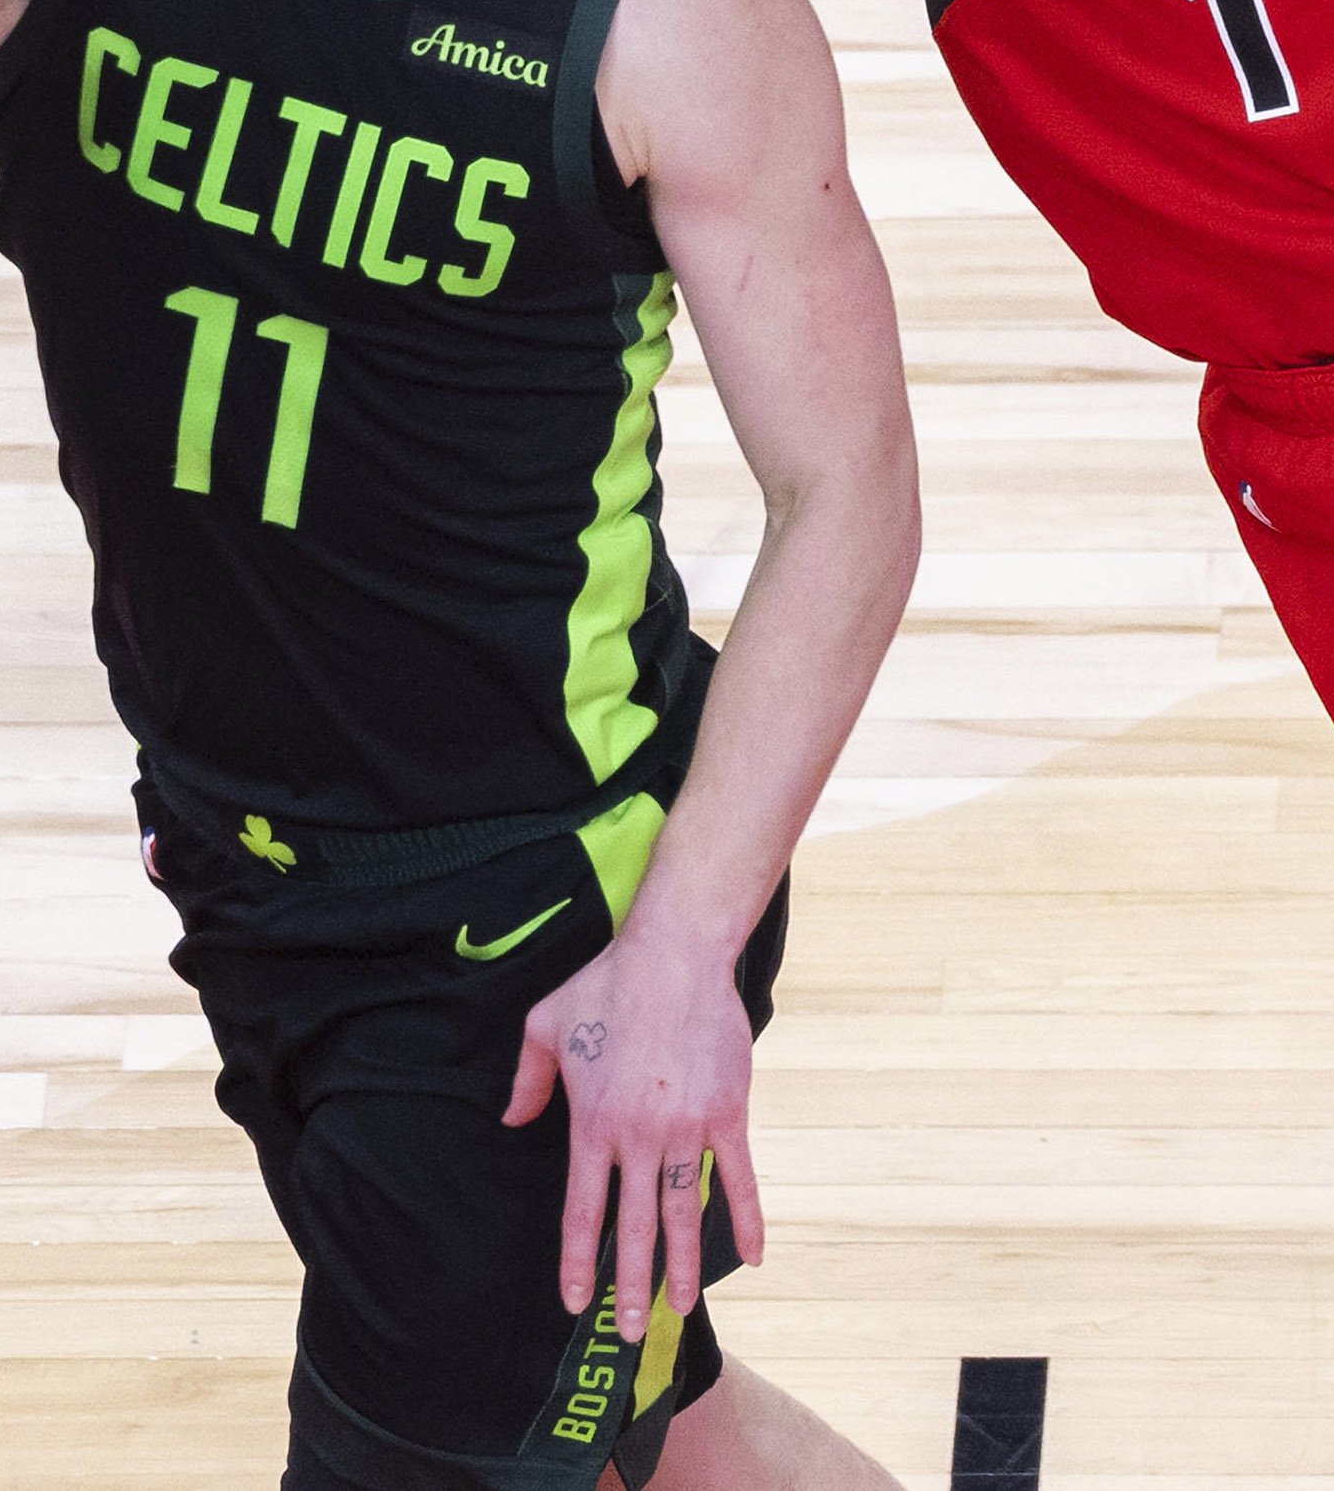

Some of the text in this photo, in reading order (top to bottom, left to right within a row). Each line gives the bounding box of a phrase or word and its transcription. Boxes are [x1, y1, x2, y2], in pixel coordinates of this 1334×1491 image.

[77, 25, 531, 298] CELTICS
[410, 23, 549, 88] Amica
[163, 285, 330, 531] 11
